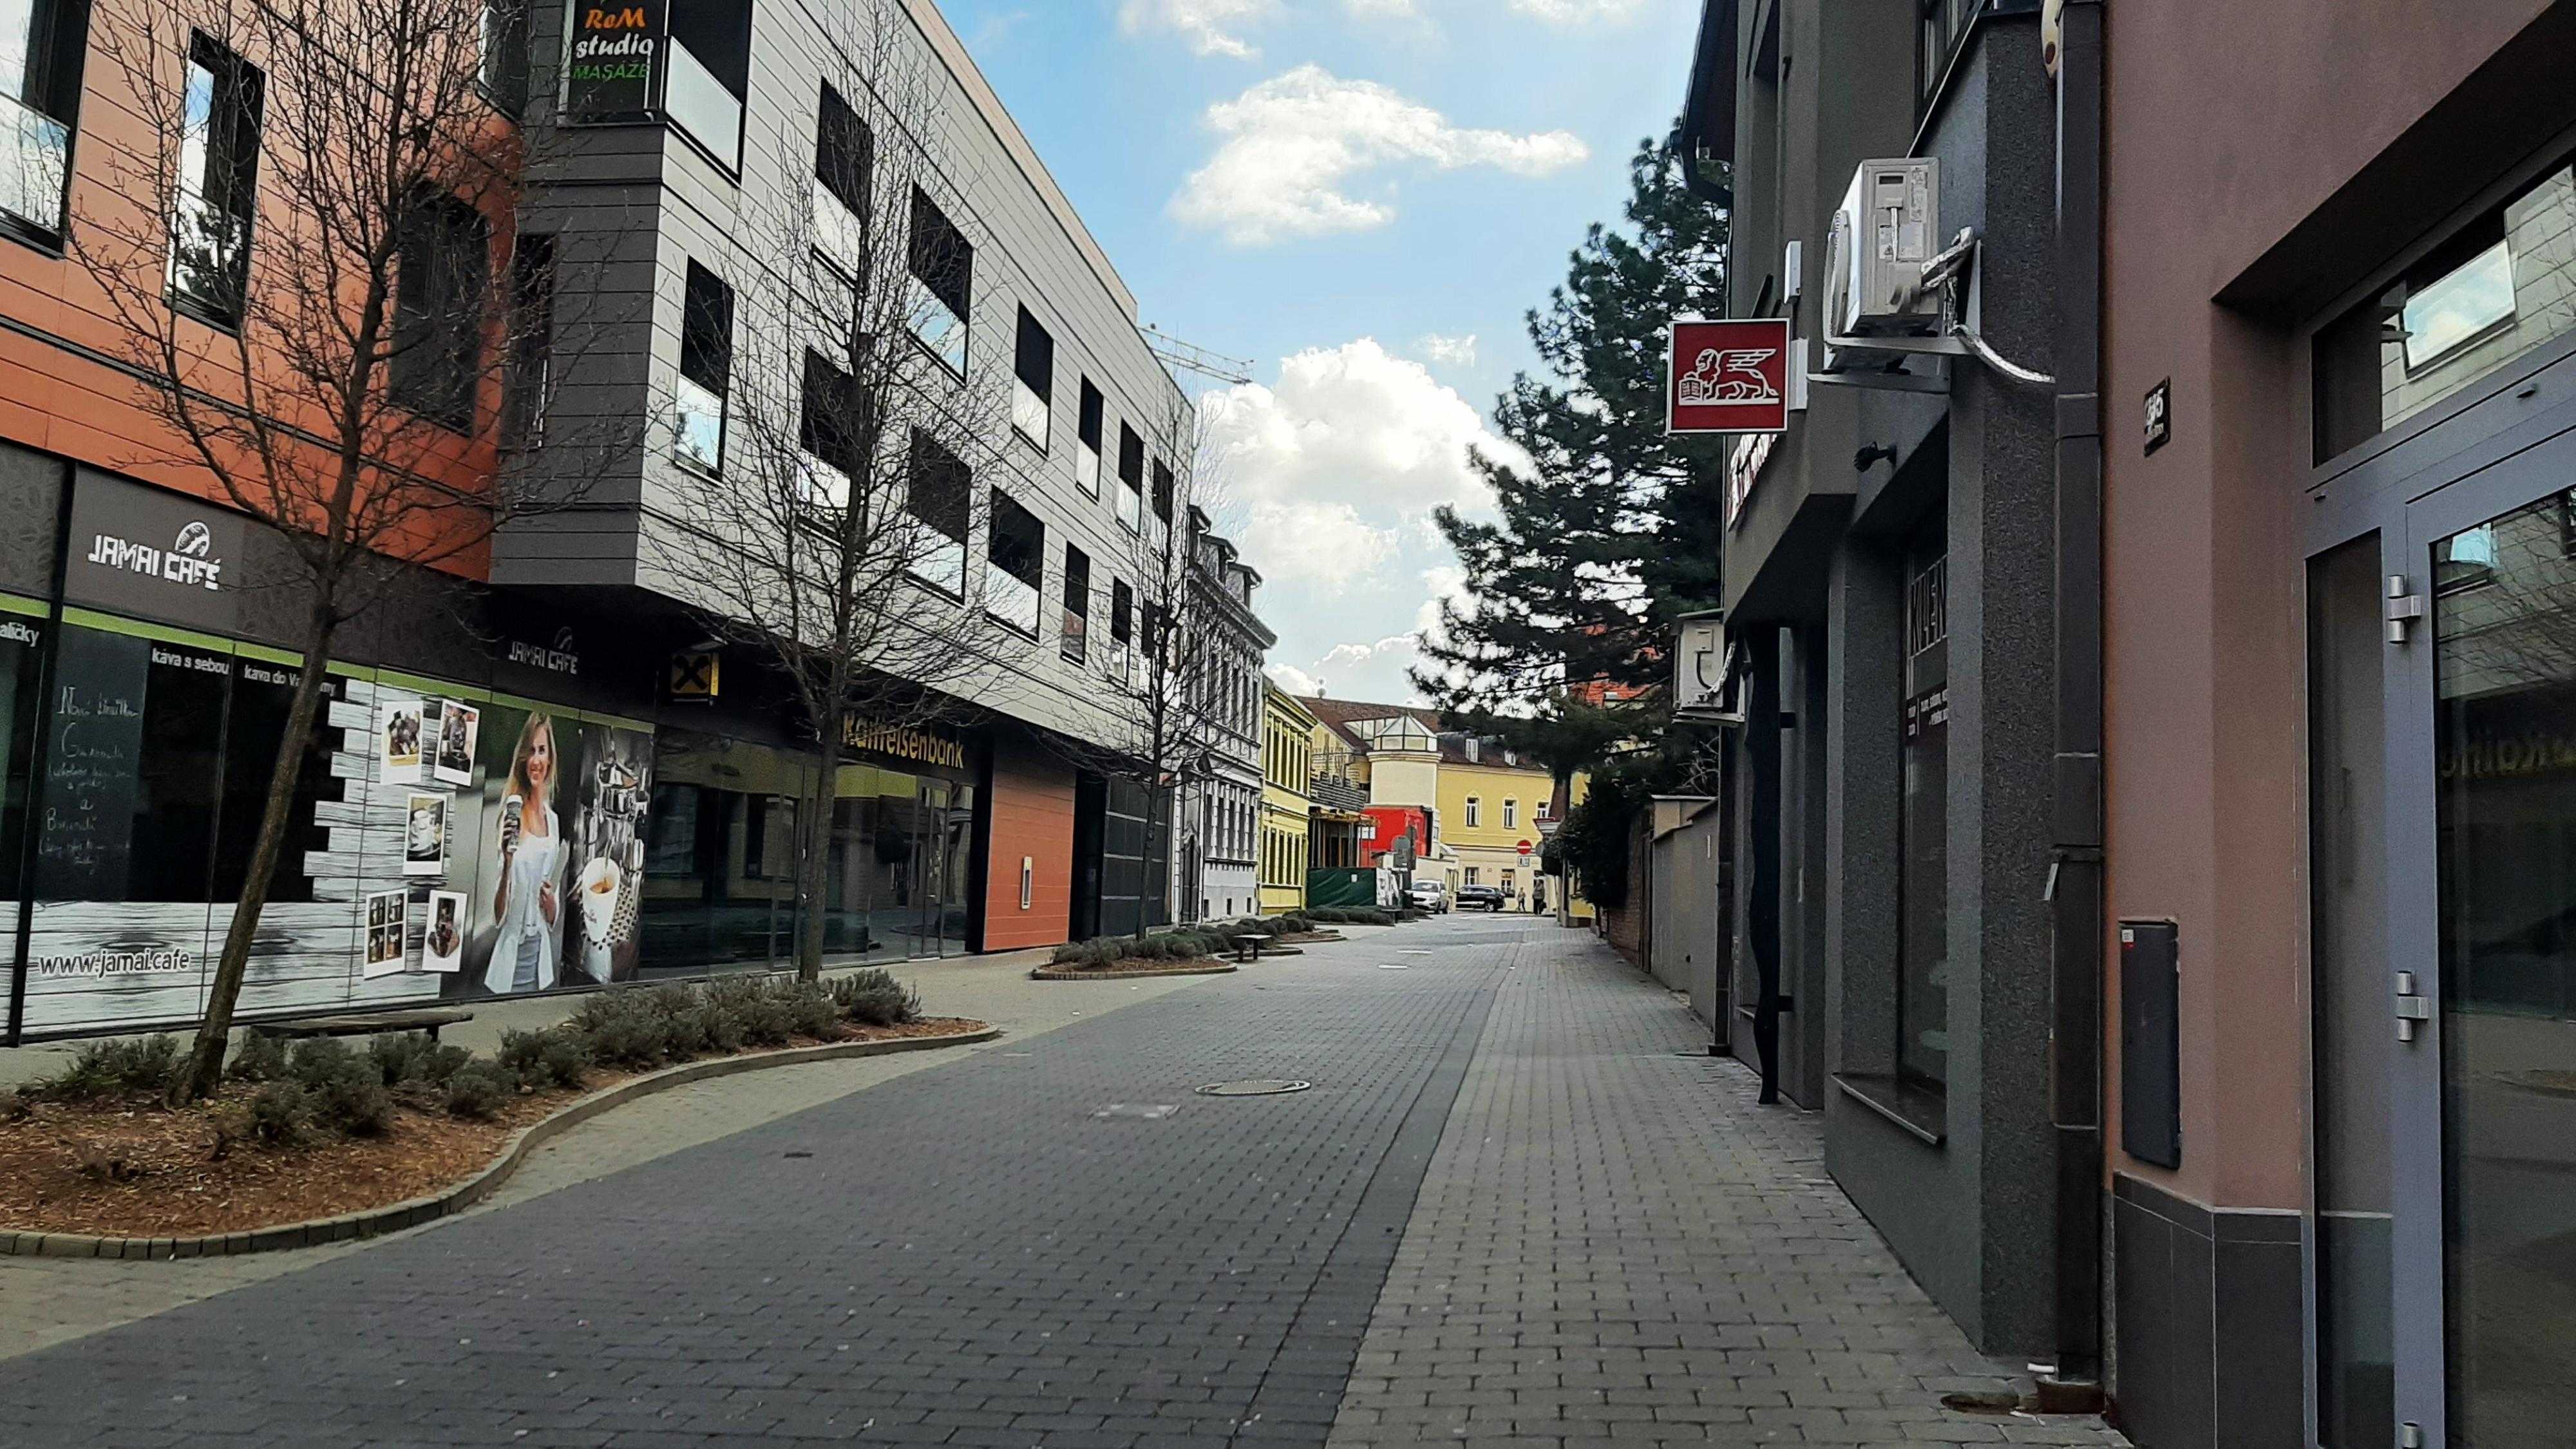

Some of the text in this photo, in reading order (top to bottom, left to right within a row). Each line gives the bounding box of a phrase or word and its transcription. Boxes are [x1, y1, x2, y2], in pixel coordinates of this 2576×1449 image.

[576, 32, 654, 59] studio
[88, 534, 160, 576] JAMAI
[164, 551, 221, 591] CAFÉ
[0, 621, 39, 647] aličky
[152, 647, 229, 676] káva s sebou
[272, 670, 287, 685] do
[39, 948, 190, 979] www.jamai.cafe
